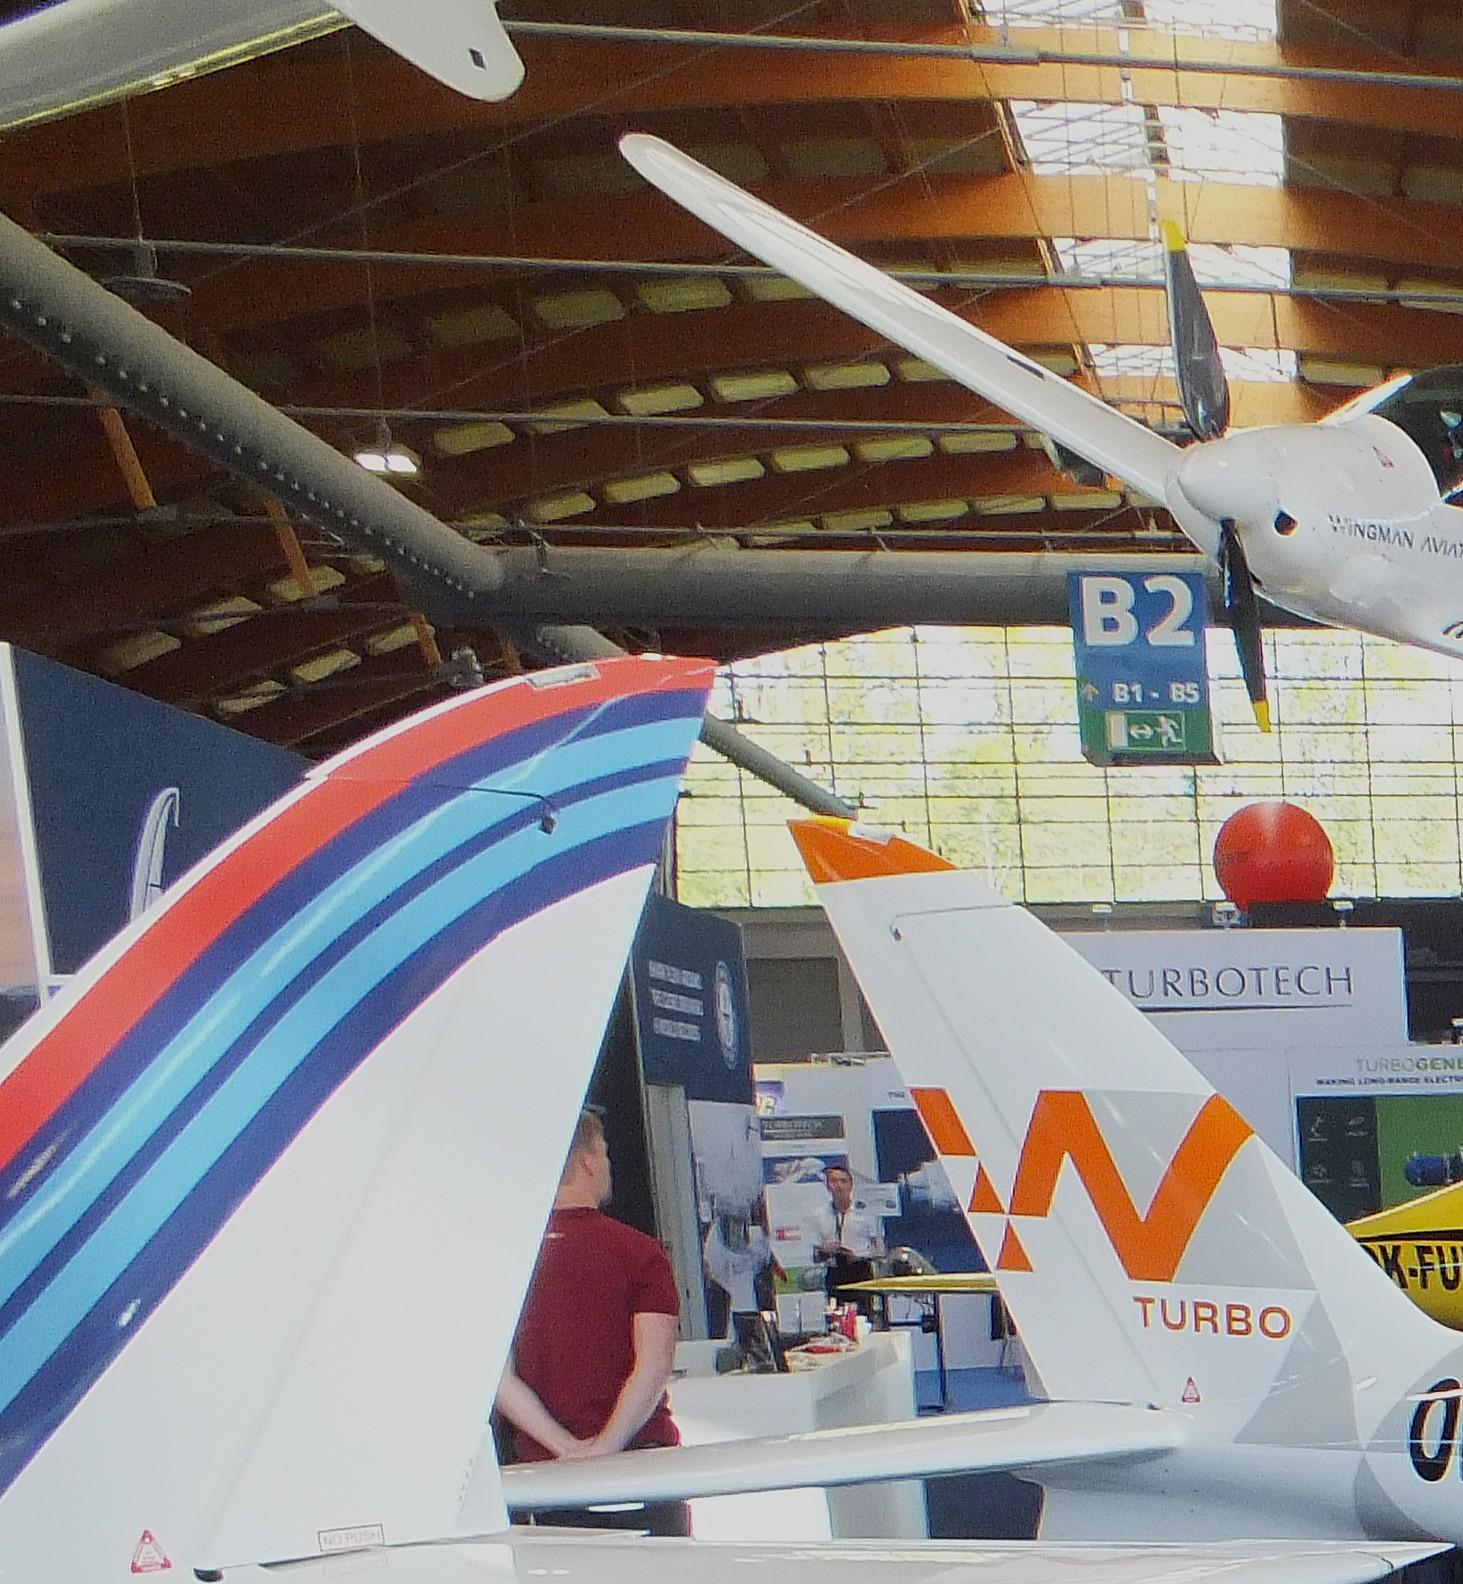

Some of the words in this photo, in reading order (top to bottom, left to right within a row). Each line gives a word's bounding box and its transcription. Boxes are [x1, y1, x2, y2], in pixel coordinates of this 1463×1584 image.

[1329, 514, 1414, 549] WINGMAN
[1081, 575, 1196, 646] B2
[1112, 682, 1142, 702] B1
[1101, 966, 1352, 998] TURBOTECH
[1133, 1296, 1291, 1339] TURBO
